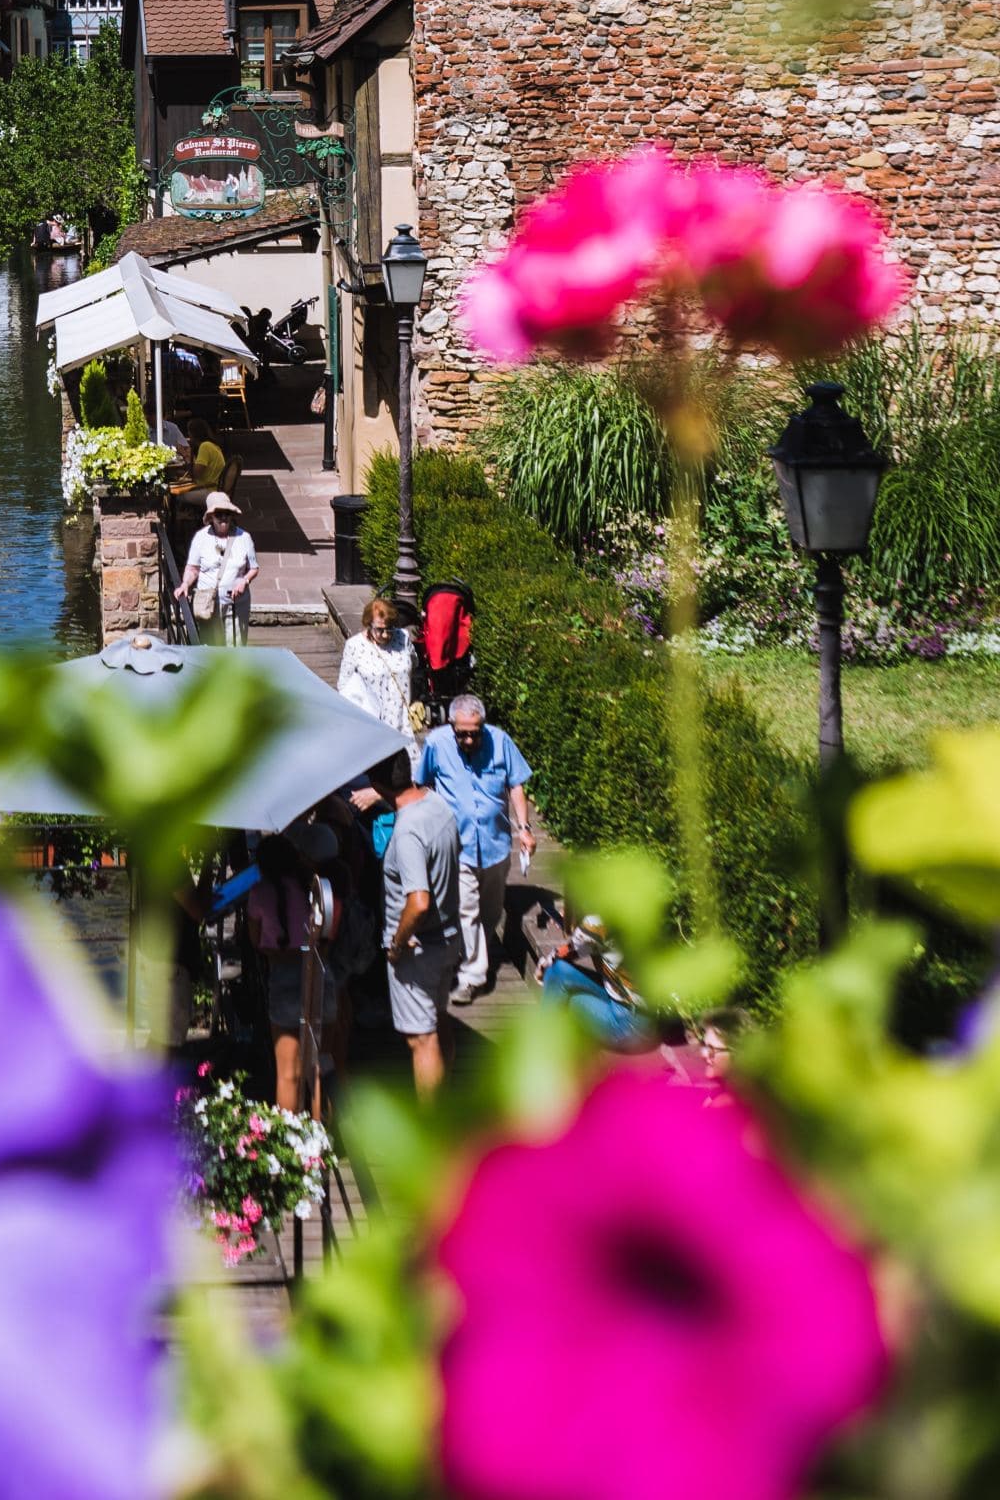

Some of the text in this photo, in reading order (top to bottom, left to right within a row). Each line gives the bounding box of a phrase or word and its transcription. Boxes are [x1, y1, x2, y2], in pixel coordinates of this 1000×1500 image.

[211, 137, 225, 148] St
[227, 138, 256, 150] Pierre
[194, 148, 239, 156] Restaurant
